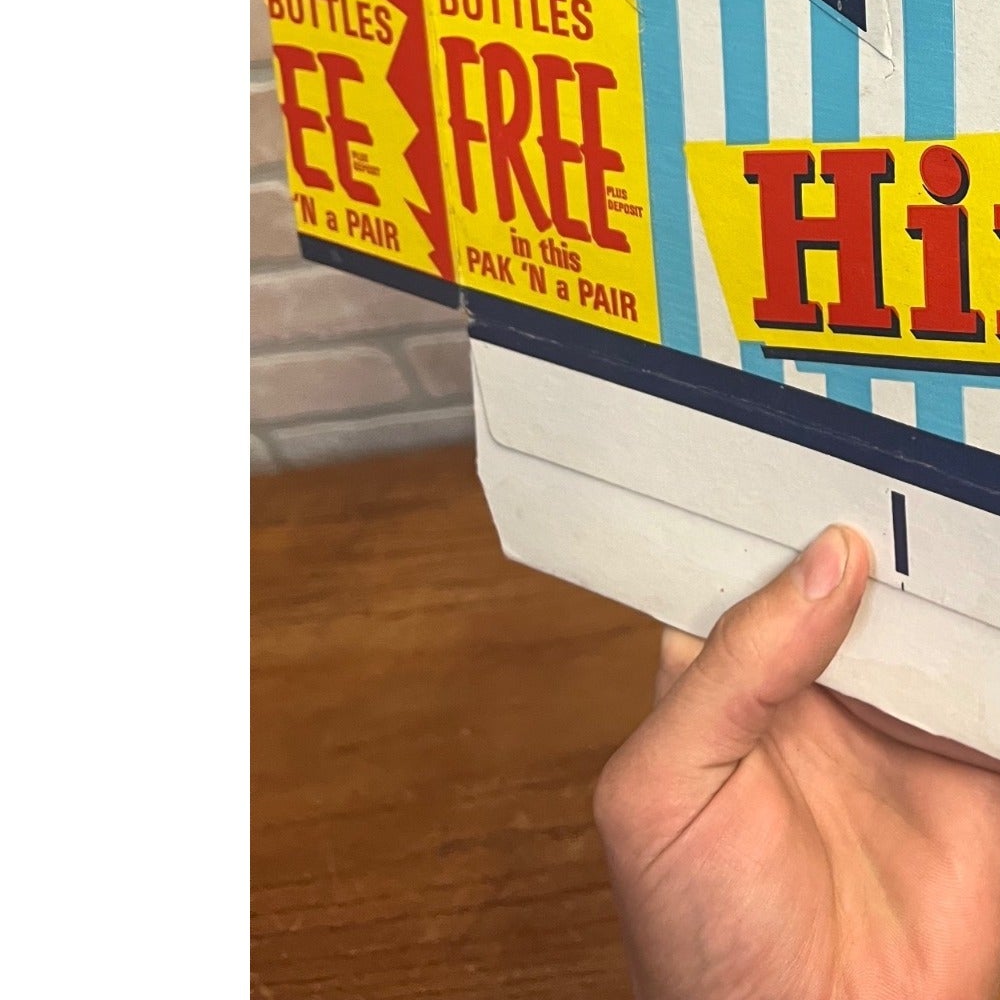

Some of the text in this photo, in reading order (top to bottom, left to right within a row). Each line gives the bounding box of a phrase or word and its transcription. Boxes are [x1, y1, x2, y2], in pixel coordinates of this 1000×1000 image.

[272, 44, 382, 208] EE
[440, 35, 632, 254] FREE
[606, 185, 629, 200] PLUS
[607, 199, 645, 218] DEPOSIT
[326, 210, 339, 232] a
[347, 208, 402, 252] PAIR
[509, 226, 582, 273] in this
[466, 245, 517, 286] PAK
[556, 279, 570, 302] a
[578, 277, 639, 323] PAIR
